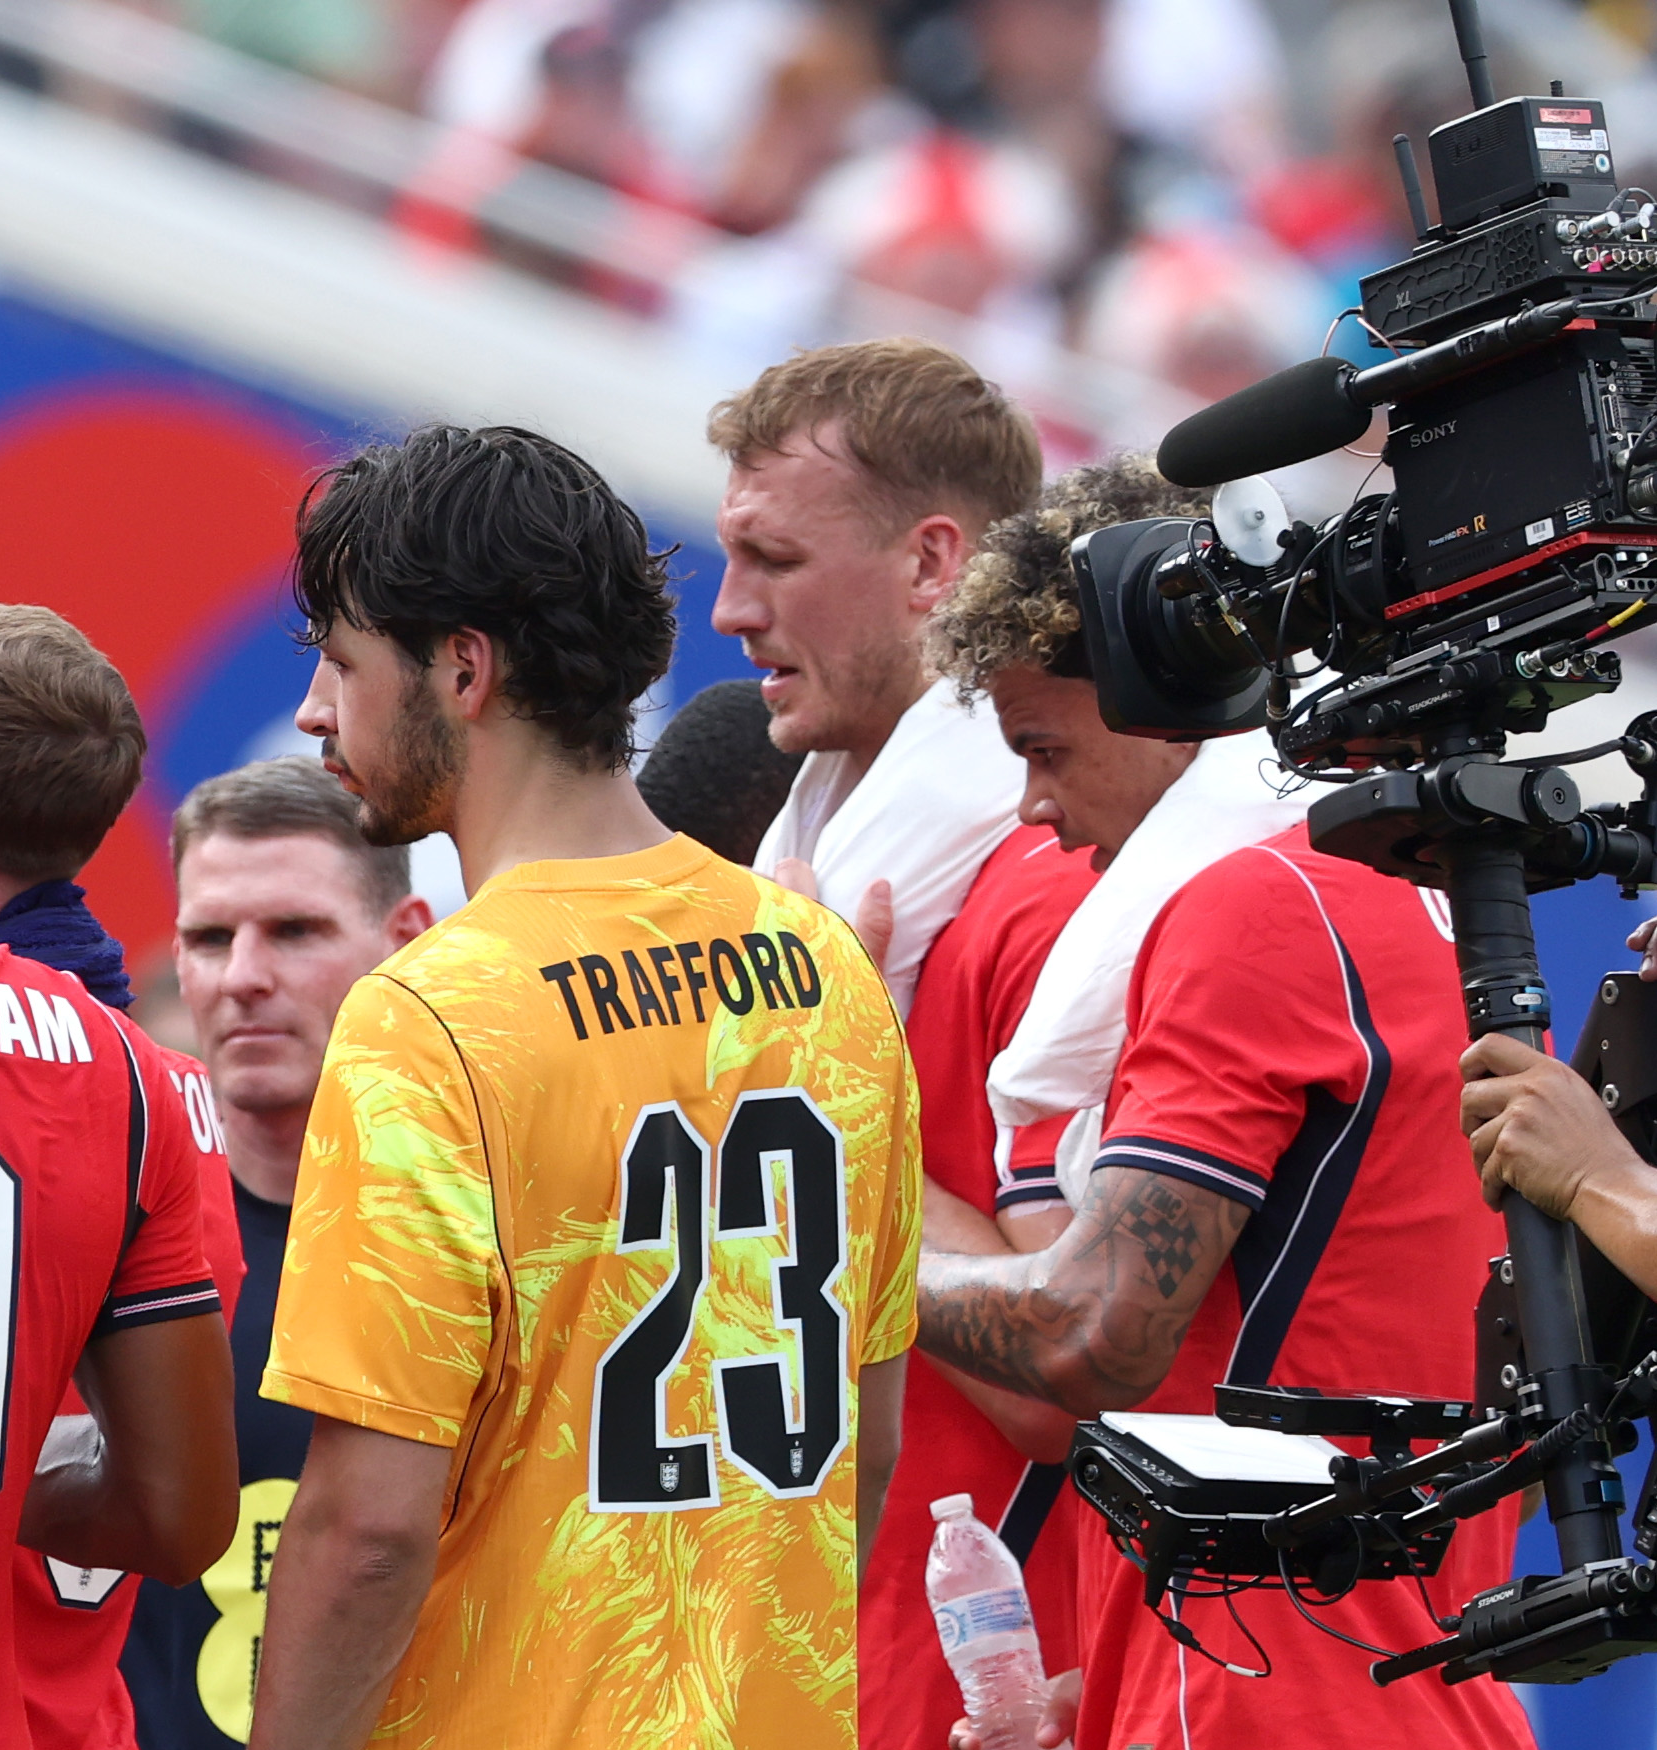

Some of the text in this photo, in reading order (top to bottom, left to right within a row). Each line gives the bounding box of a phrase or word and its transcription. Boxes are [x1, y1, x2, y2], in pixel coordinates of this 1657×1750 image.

[1410, 420, 1457, 448] SONY
[540, 930, 823, 1041] TRAFFORD
[588, 1086, 848, 1513] 23
